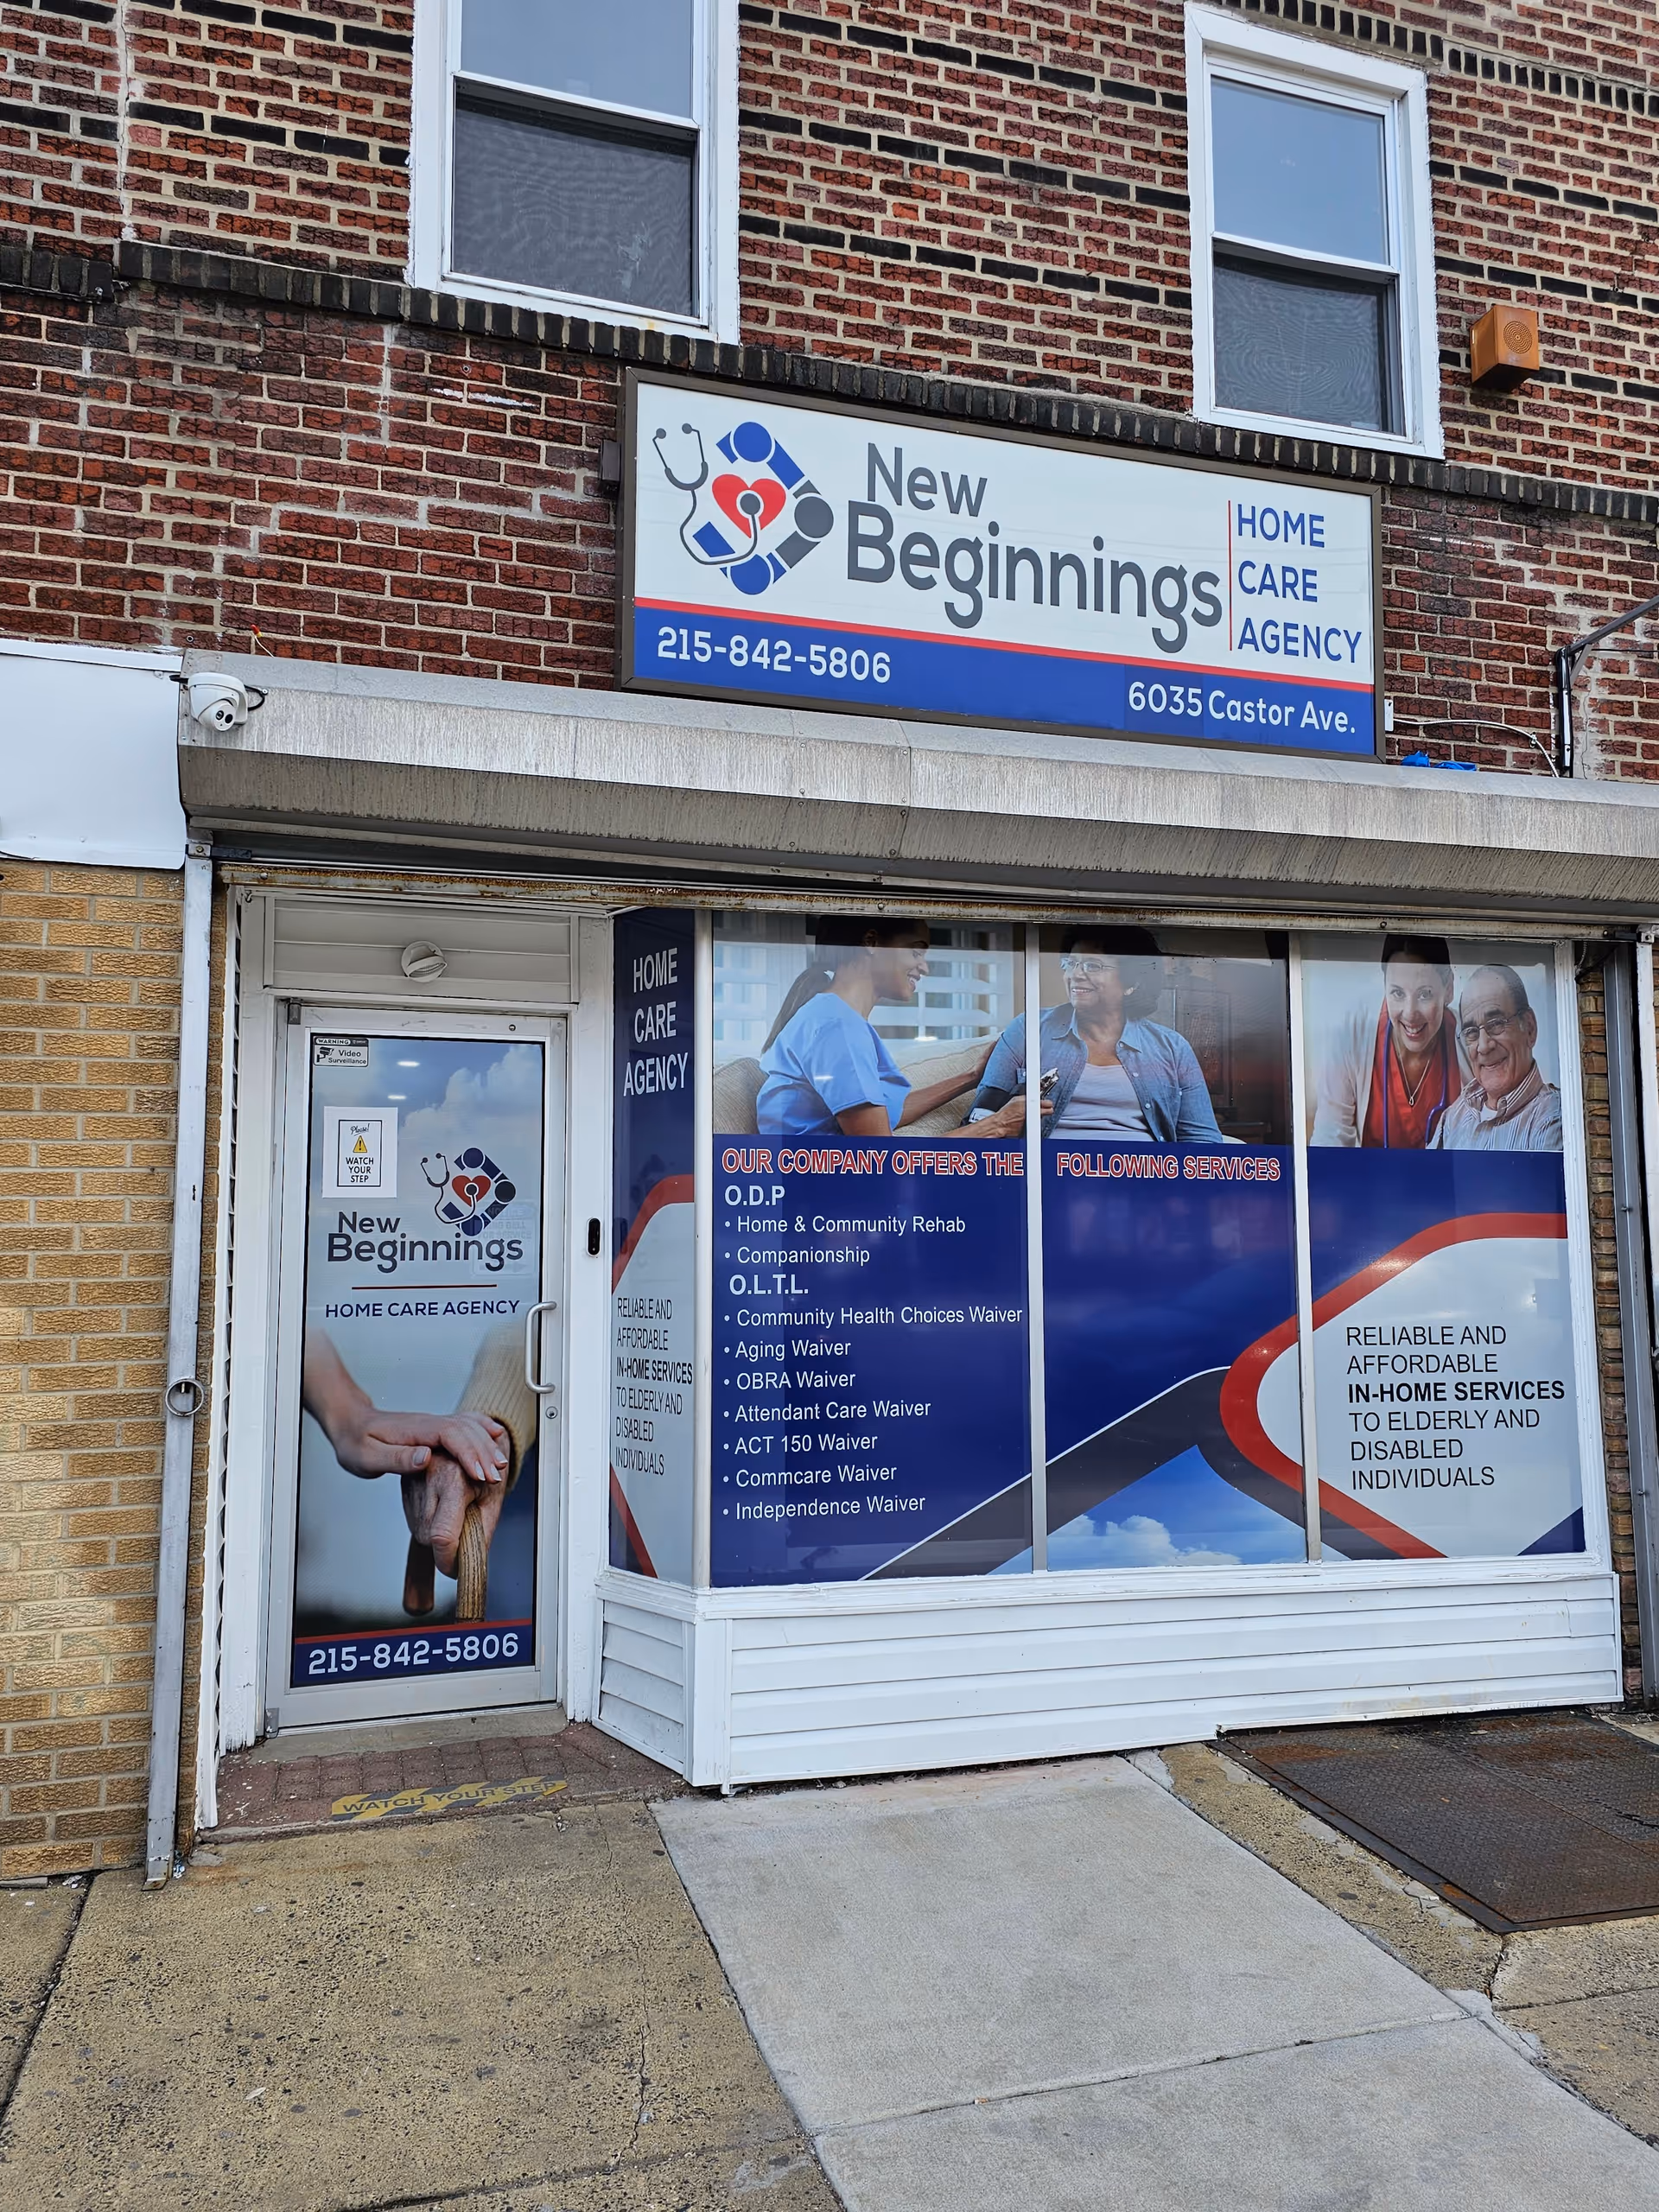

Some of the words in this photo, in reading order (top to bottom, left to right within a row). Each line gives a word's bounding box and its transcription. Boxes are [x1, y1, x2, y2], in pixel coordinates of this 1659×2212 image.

[868, 442, 988, 517] New
[1238, 504, 1325, 549] HOME
[848, 501, 1223, 653] Beginnings
[1238, 559, 1318, 603] CARE
[1238, 617, 1362, 664] AGENCY
[658, 626, 891, 683] 215-842-5806
[1128, 681, 1204, 717] 6035
[1208, 689, 1295, 727] Castor
[1300, 701, 1356, 734] Ave.
[633, 947, 678, 993] HOME
[634, 1001, 677, 1044] CARE
[623, 1052, 689, 1097] AGENCY
[348, 1166, 372, 1174] YOUR
[721, 1148, 773, 1173] OUR
[778, 1148, 888, 1174] COMPANY
[892, 1150, 977, 1175] OFFERS
[982, 1152, 1024, 1176] THE
[1057, 1153, 1179, 1179] FOLLOWING
[1183, 1156, 1281, 1181] SERVICES
[724, 1185, 785, 1206] O.D.P
[338, 1211, 401, 1234] New
[737, 1215, 788, 1233] Home
[794, 1217, 806, 1233] &
[812, 1215, 907, 1236] Community
[912, 1216, 966, 1234] Rehab
[327, 1232, 524, 1274] Beginnings
[737, 1247, 870, 1267] Companionship
[729, 1274, 809, 1295] O.L.T.L.
[326, 1303, 383, 1318] HOME
[388, 1301, 439, 1317] CARE
[442, 1300, 520, 1315] AGENCY
[617, 1297, 654, 1319] RELIABLE
[655, 1299, 672, 1320] AND
[737, 1308, 835, 1328] Community
[841, 1307, 895, 1325] Health
[900, 1306, 964, 1324] Choices
[969, 1306, 1023, 1323] Waiver
[616, 1327, 669, 1351] AFFORDABLE
[1346, 1325, 1454, 1346] RELIABLE
[1460, 1325, 1506, 1345] AND
[735, 1341, 785, 1362] Aging
[792, 1339, 851, 1357] Waiver
[616, 1357, 650, 1380] IN-HOME
[652, 1360, 693, 1385] SERVICES
[1346, 1353, 1498, 1375] AFFORDABLE
[736, 1372, 791, 1389] OBRA
[797, 1370, 855, 1389] Waiver
[1348, 1382, 1447, 1403] IN-HOME
[1454, 1380, 1565, 1402] SERVICES
[616, 1386, 626, 1408] TO
[629, 1388, 664, 1413] ELDERLY
[664, 1393, 683, 1415] AND
[734, 1403, 821, 1422] Attendant
[826, 1401, 867, 1420] Care
[873, 1400, 931, 1418] Waiver
[616, 1416, 654, 1442] DISABLED
[1349, 1412, 1381, 1432] TO
[1389, 1409, 1489, 1431] ELDERLY
[1493, 1408, 1540, 1428] AND
[734, 1436, 774, 1454] ACT
[781, 1434, 812, 1452] 150
[818, 1433, 878, 1451] Waiver
[1351, 1439, 1464, 1461] DISABLED
[615, 1446, 664, 1476] INDIVIDUALS
[736, 1467, 832, 1487] Commcare
[837, 1464, 897, 1483] Waiver
[1352, 1466, 1495, 1491] INDIVIDUALS
[736, 1499, 861, 1522] Independence
[867, 1495, 925, 1513] Waiver
[308, 1632, 519, 1675] 215-842-5806
[343, 1796, 424, 1813] WATCH
[433, 1789, 496, 1802] YOUR
[500, 1782, 556, 1796] STEP
